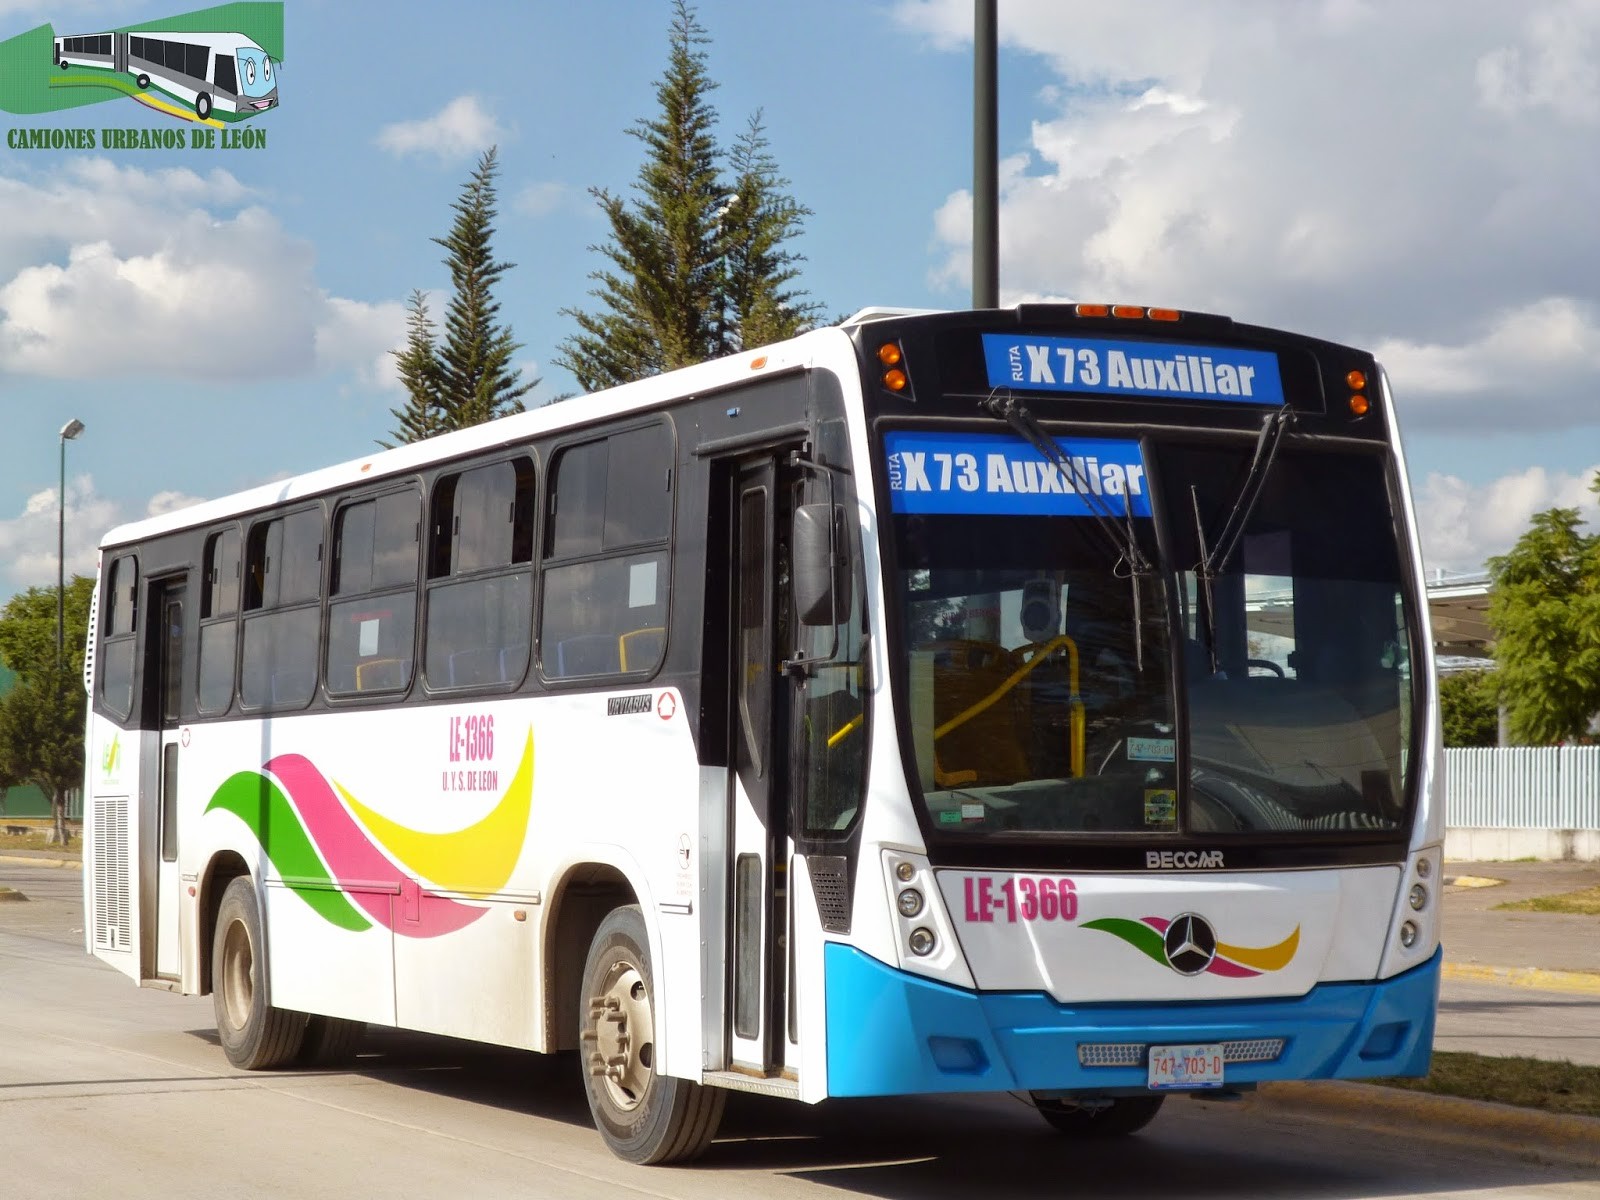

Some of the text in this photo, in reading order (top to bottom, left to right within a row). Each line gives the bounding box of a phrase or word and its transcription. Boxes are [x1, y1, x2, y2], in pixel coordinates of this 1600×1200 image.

[1011, 344, 1255, 397] RUTA X 73 Auxiliar
[890, 452, 903, 491] RUTA
[901, 452, 932, 492] X
[934, 453, 980, 492] 73
[450, 714, 494, 762] LE-1366
[467, 770, 477, 791] DE
[479, 770, 498, 791] LEON
[1146, 851, 1224, 869] BECCAR
[964, 877, 1078, 923] LE-1366
